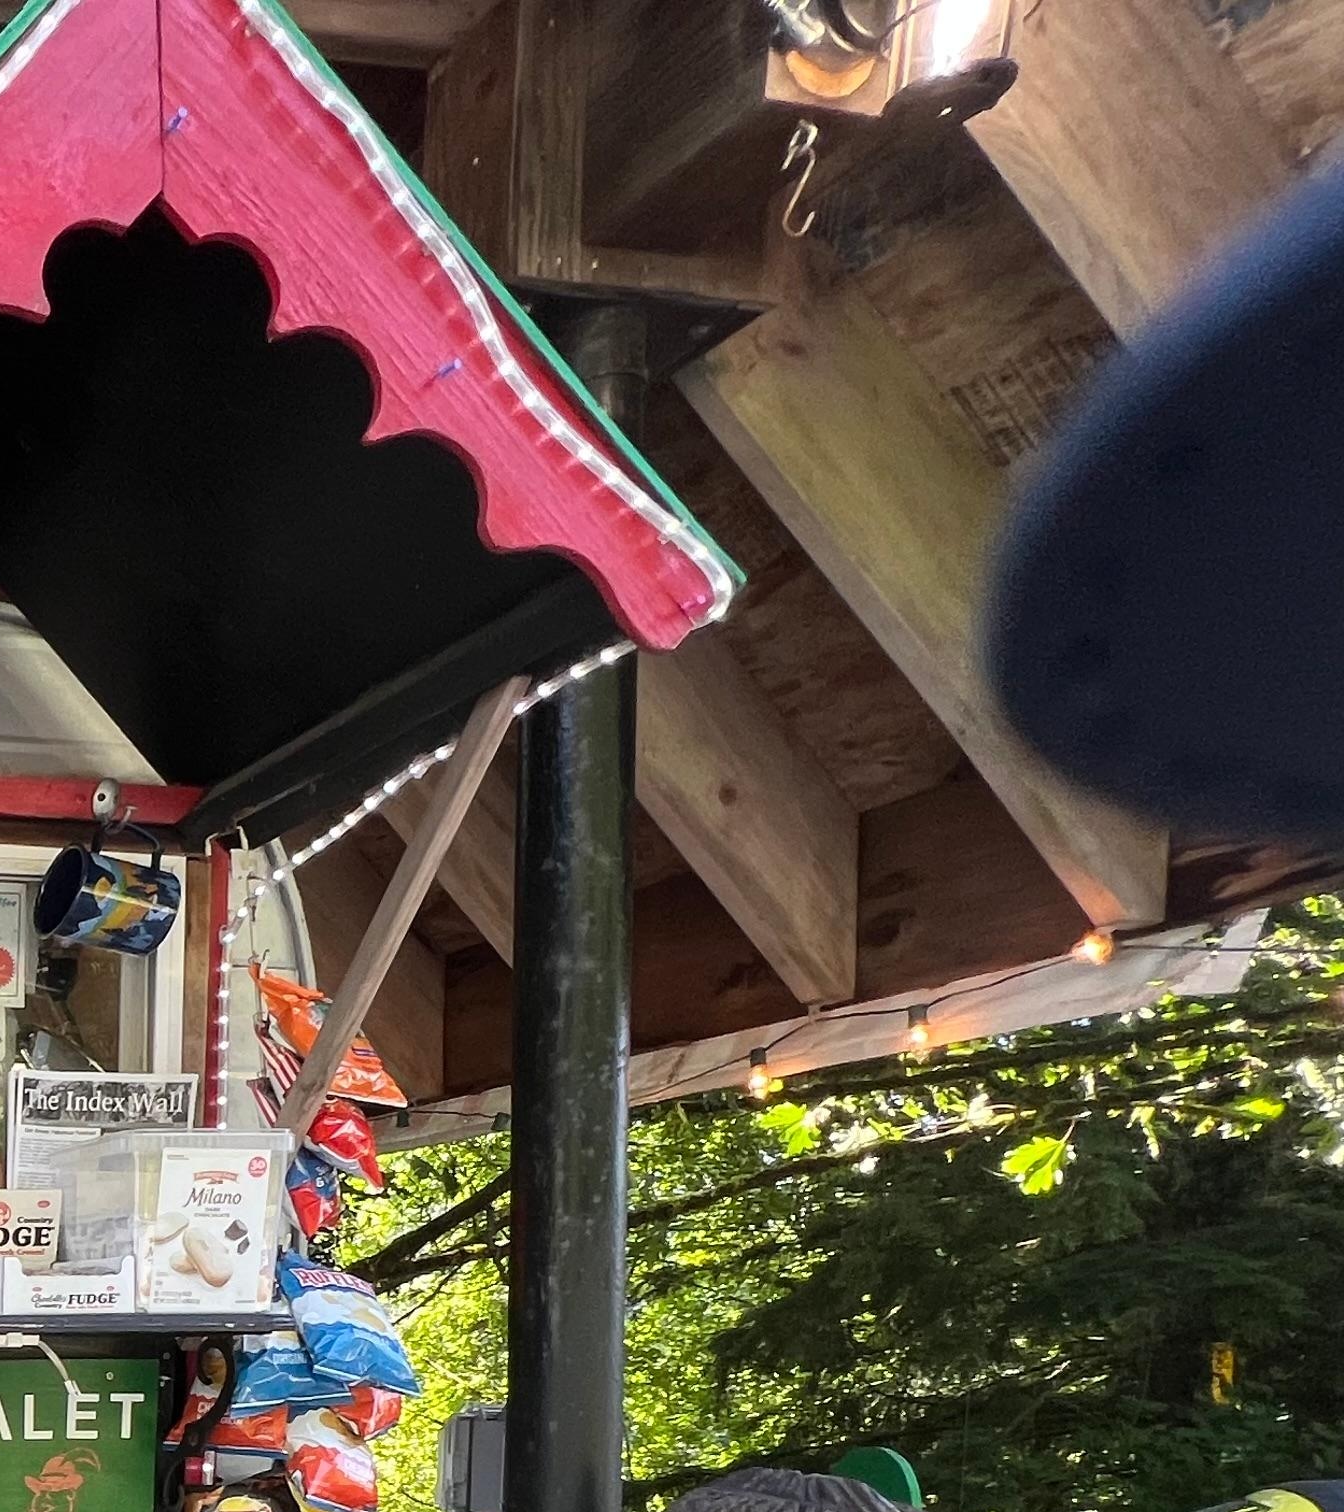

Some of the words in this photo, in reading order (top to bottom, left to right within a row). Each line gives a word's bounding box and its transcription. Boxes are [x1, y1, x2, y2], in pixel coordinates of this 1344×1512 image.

[24, 1088, 59, 1111] The
[65, 1090, 125, 1112] Index
[133, 1085, 183, 1113] Wall
[182, 1187, 242, 1207] Milano
[17, 1216, 54, 1224] Country
[68, 1293, 120, 1305] FUDGE
